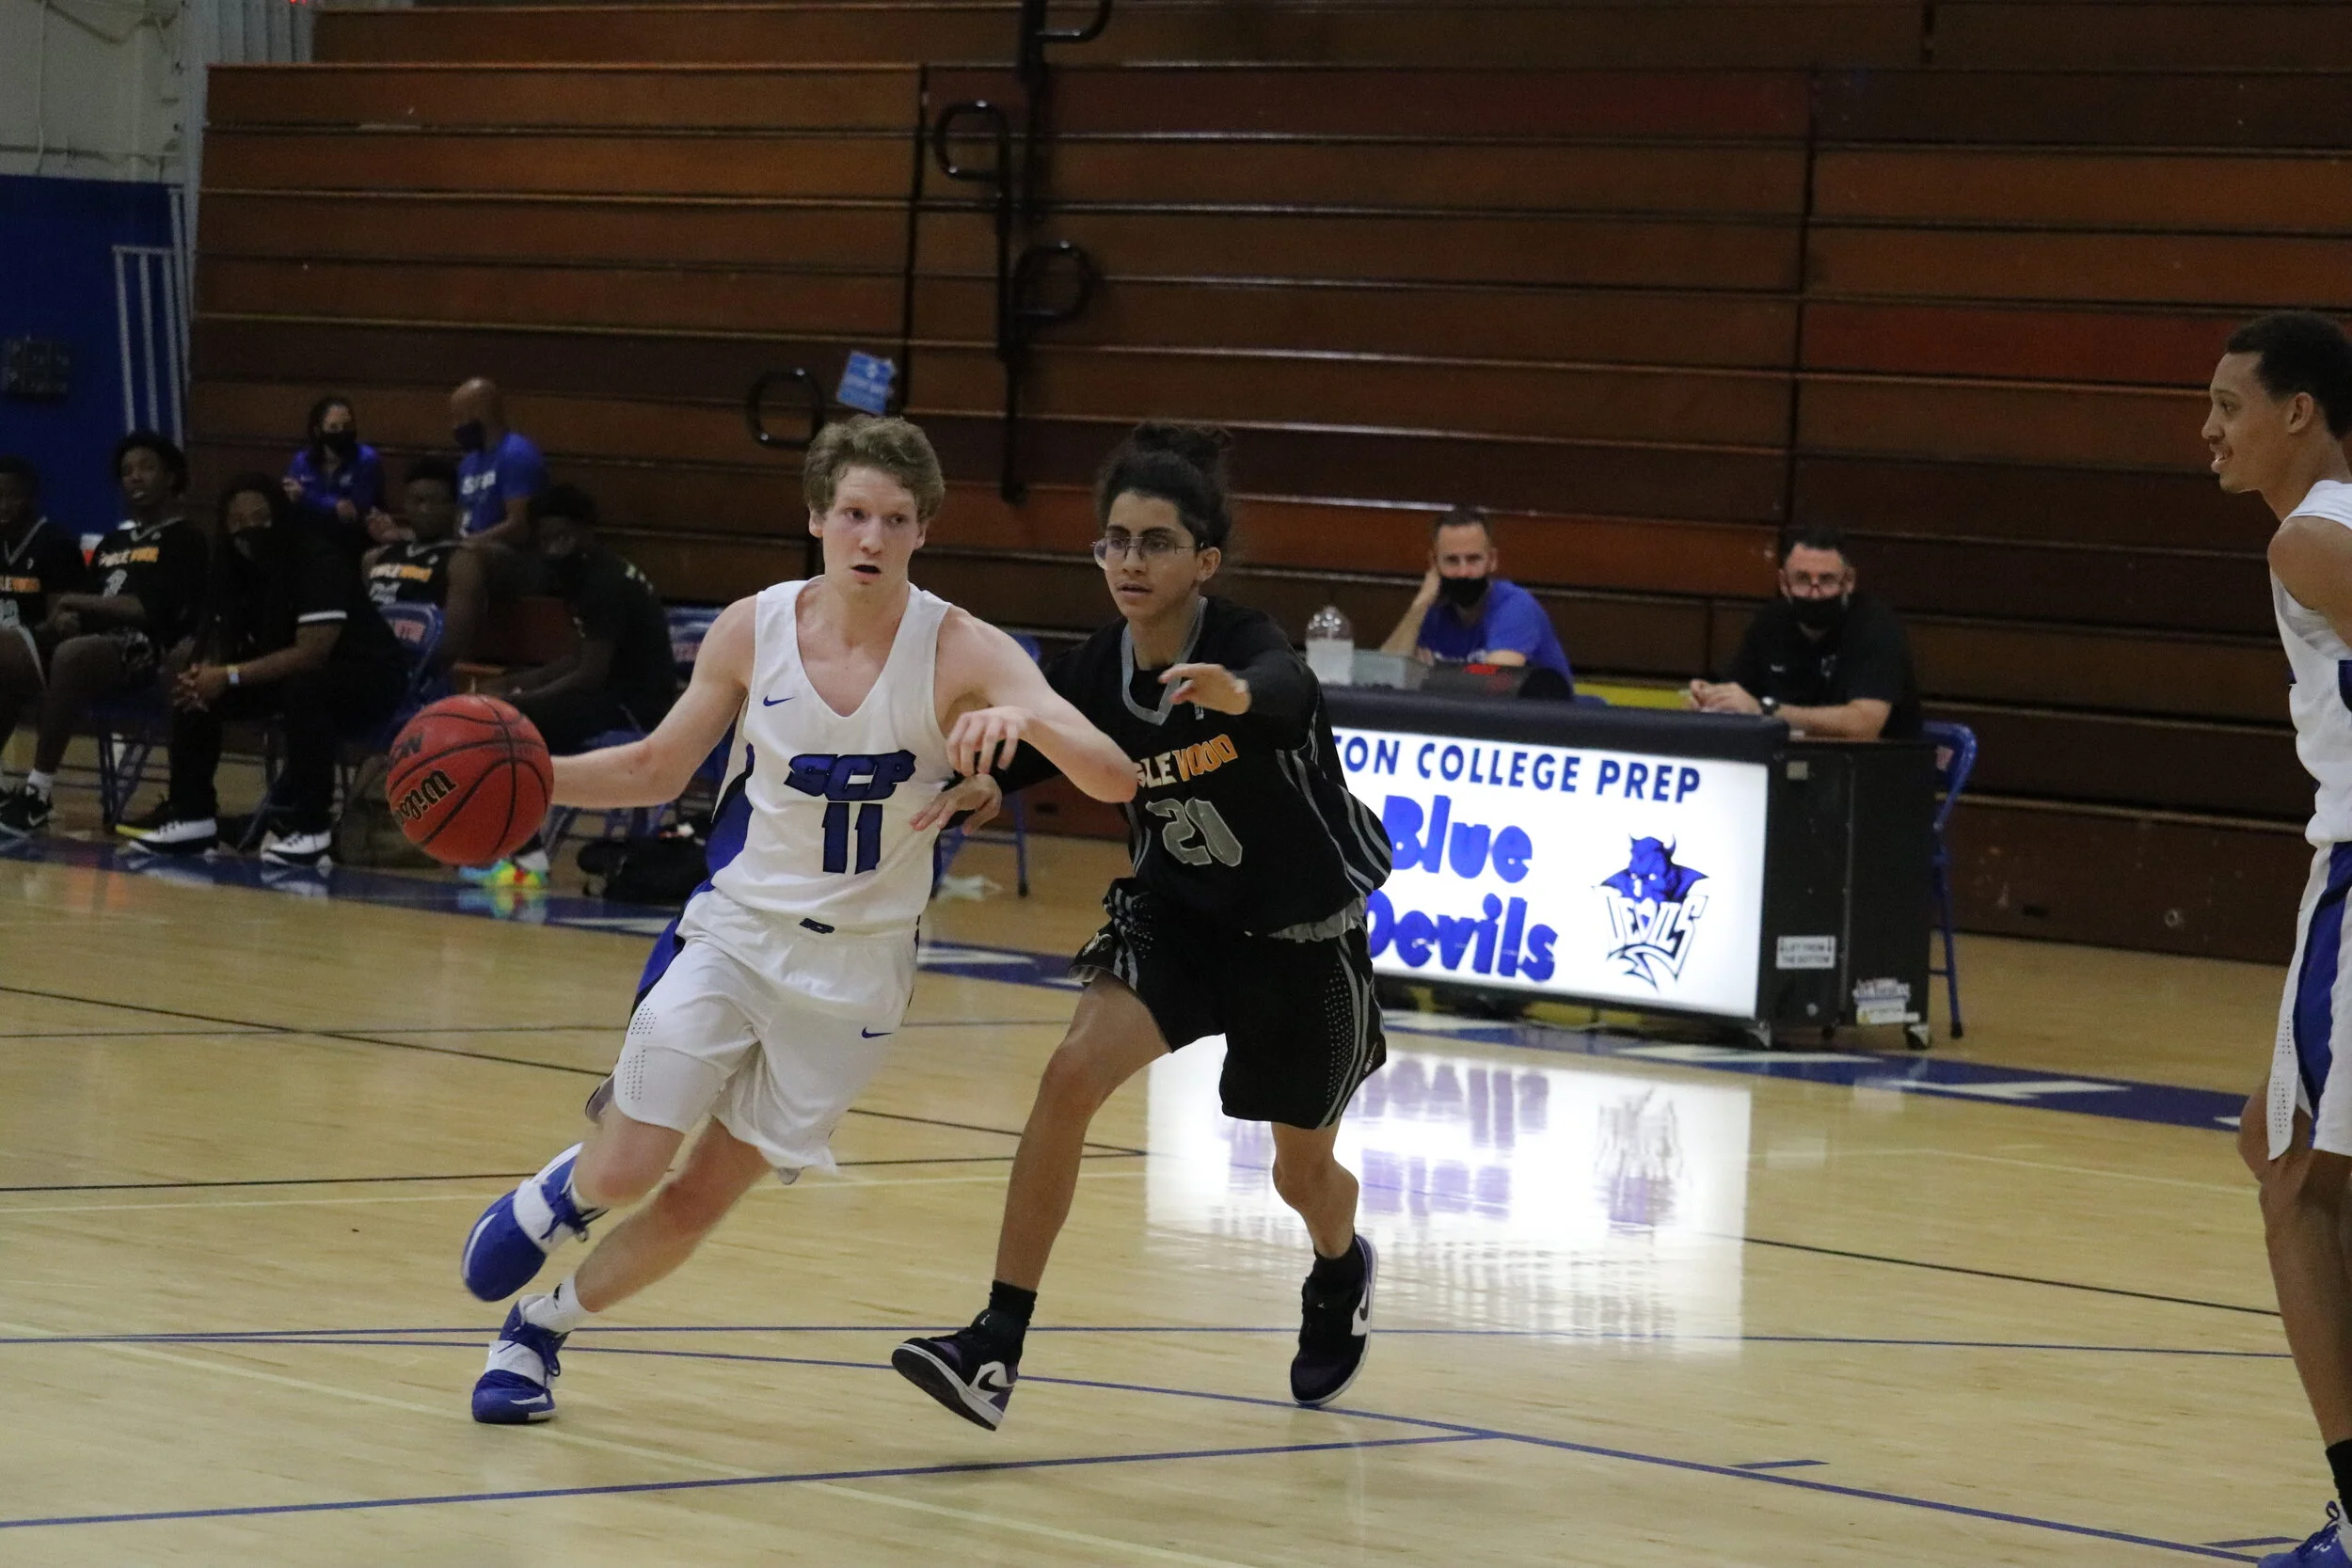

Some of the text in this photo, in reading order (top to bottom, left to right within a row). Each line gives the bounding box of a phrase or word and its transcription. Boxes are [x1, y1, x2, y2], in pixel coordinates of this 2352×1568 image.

[784, 750, 916, 800] SCP
[1333, 735, 1701, 803] ON COLLEGE PREP
[821, 802, 883, 875] 11
[1145, 797, 1243, 867] 20
[1382, 794, 1533, 883] Blue
[1593, 886, 1709, 978] DEVILS
